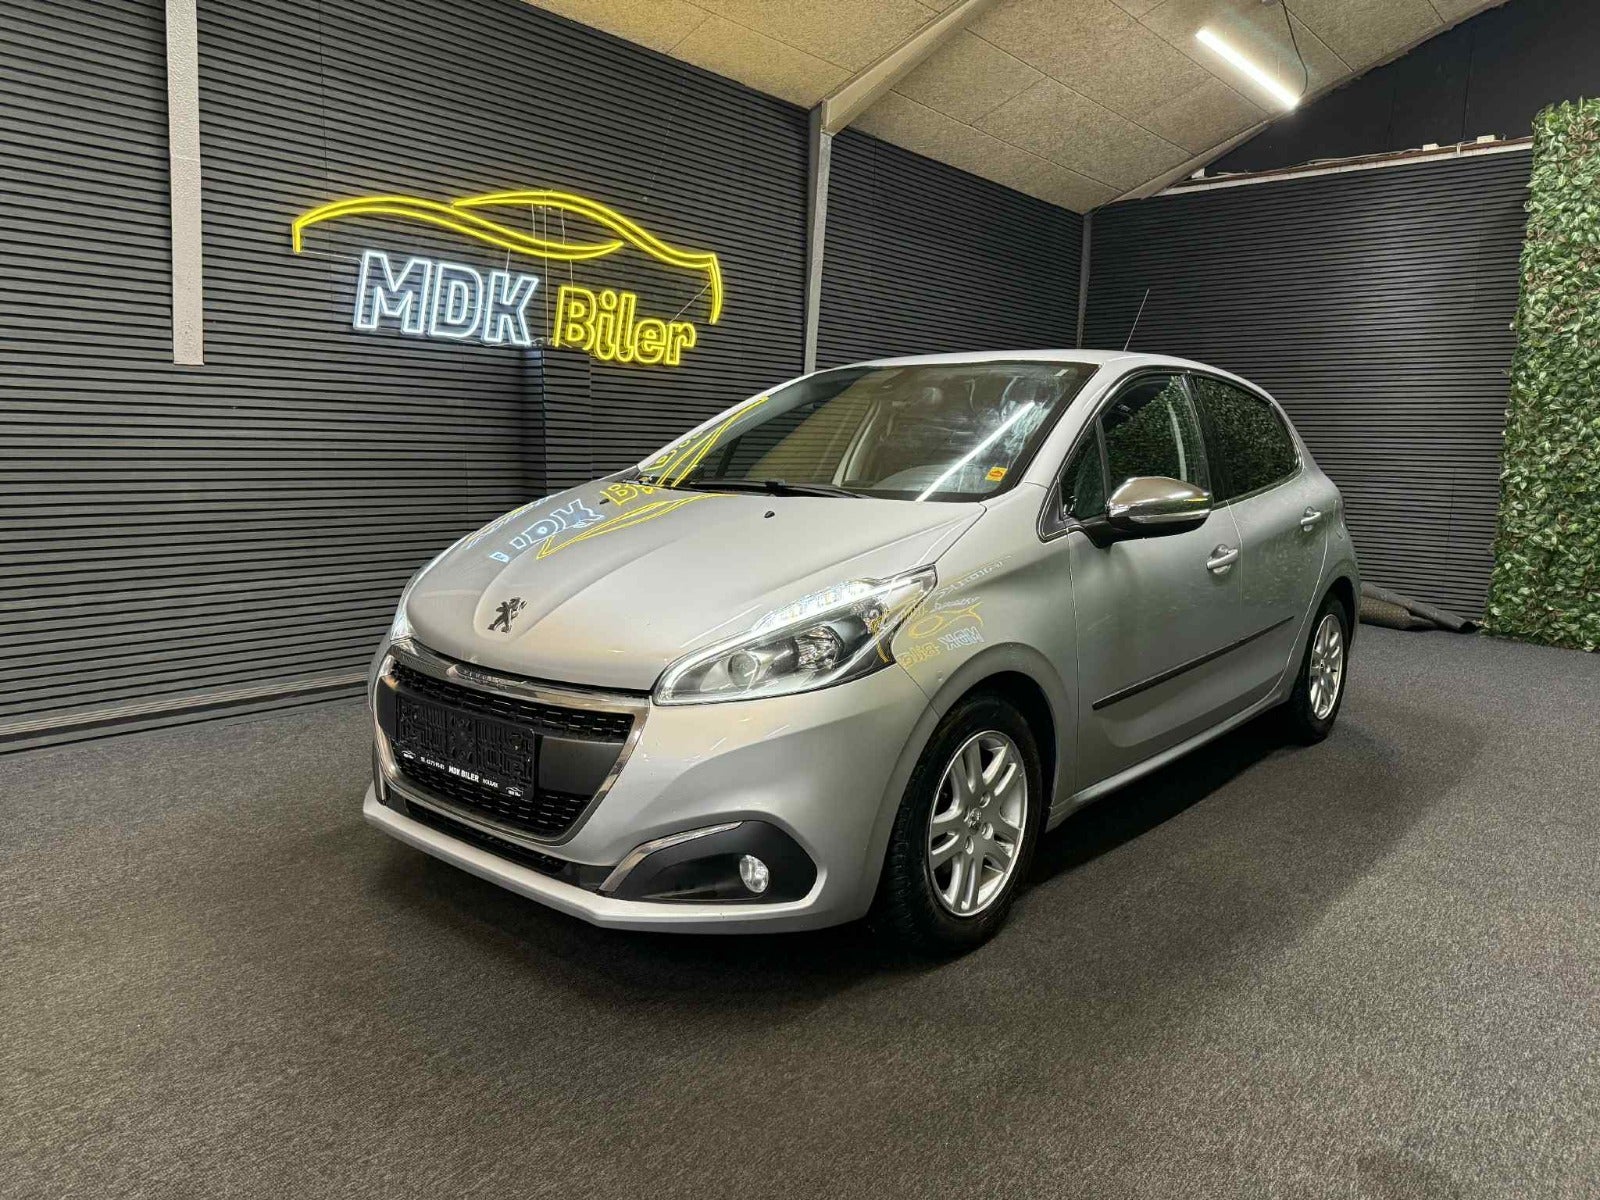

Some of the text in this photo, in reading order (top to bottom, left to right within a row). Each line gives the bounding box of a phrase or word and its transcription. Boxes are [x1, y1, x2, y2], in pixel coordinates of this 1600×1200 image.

[353, 250, 696, 367] MDK Biler
[461, 769, 480, 783] BILER
